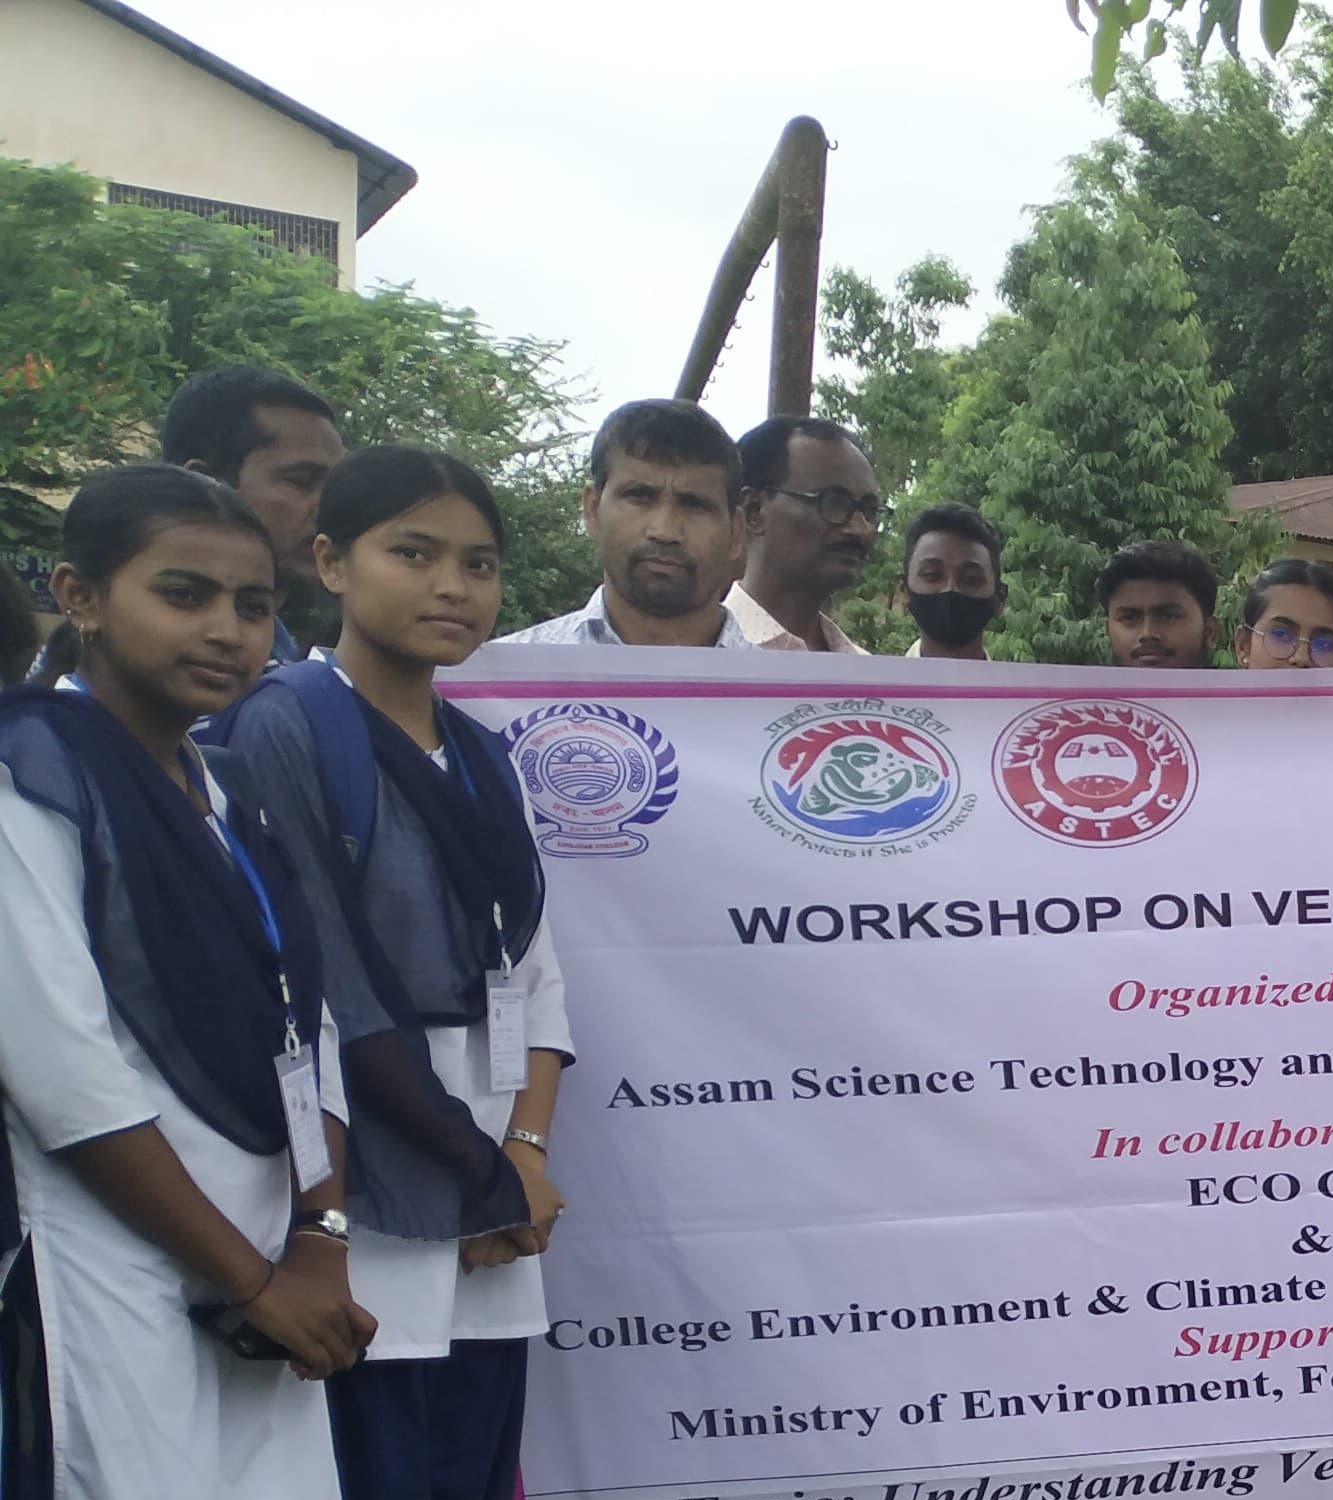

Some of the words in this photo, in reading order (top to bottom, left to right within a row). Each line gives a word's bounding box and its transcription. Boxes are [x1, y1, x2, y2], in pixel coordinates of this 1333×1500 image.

[1024, 793, 1177, 839] ASTEC
[728, 897, 1121, 944] WORKSHOP
[1144, 893, 1232, 930] ON
[606, 1077, 774, 1108] Assam
[791, 1066, 974, 1099] Science
[990, 1053, 1264, 1090] Technology
[1090, 1129, 1141, 1158] In
[1186, 1173, 1300, 1206] ECO
[1292, 1225, 1333, 1254] &
[544, 1317, 731, 1351] College
[746, 1291, 1071, 1340] Environment
[1088, 1285, 1129, 1315] &
[1146, 1275, 1326, 1310] Climate
[667, 1405, 882, 1440] Ministry
[900, 1393, 948, 1425] of
[960, 1371, 1283, 1420] Environment,
